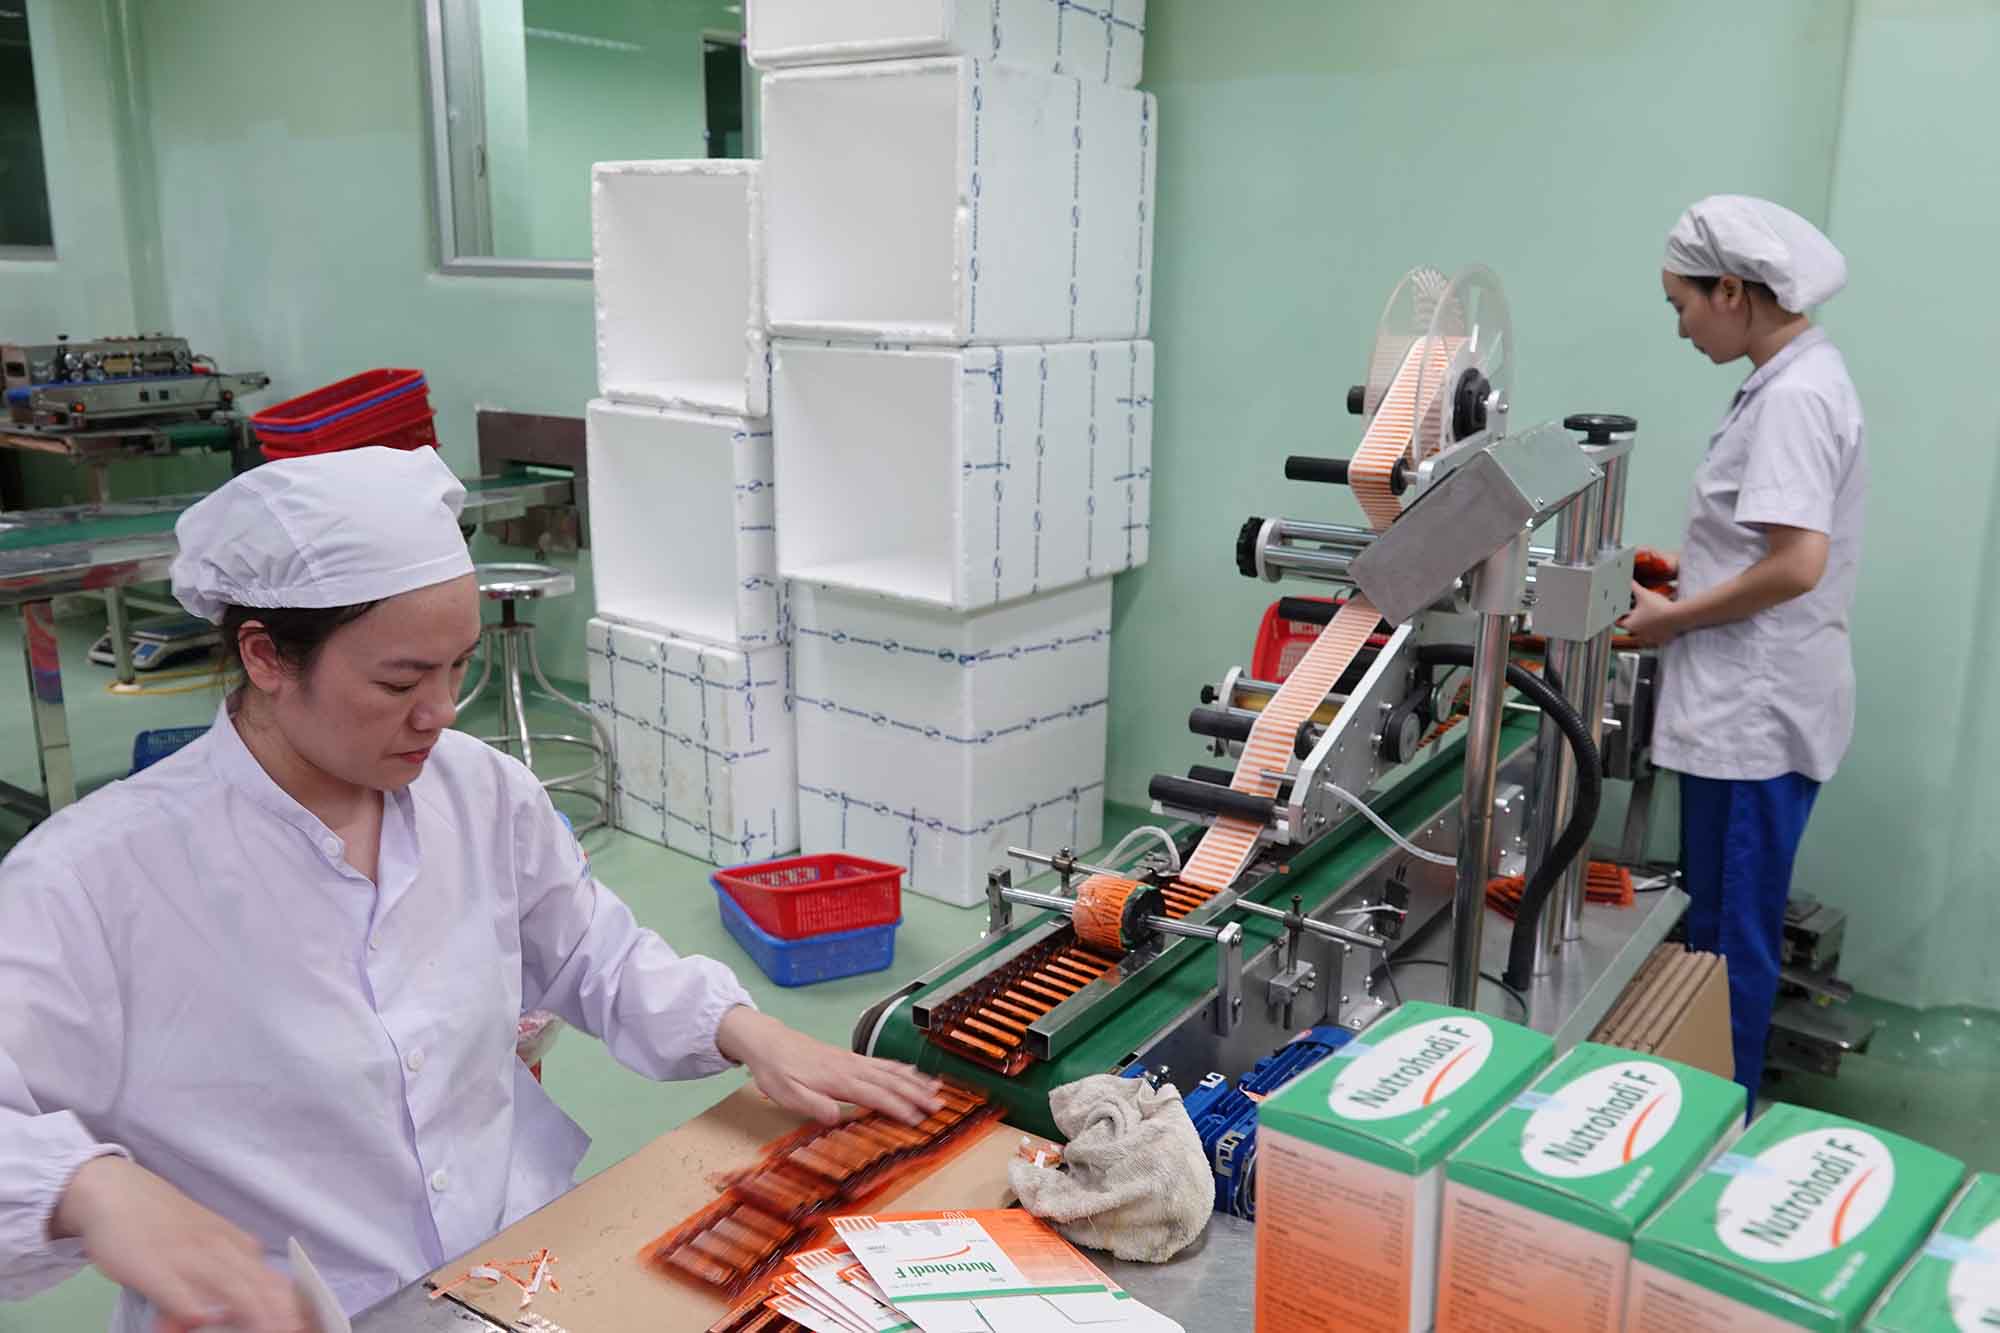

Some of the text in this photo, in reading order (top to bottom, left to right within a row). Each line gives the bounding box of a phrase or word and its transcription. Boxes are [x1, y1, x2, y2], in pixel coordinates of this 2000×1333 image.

[1348, 1024, 1471, 1109] Nutrohadi F
[1542, 1081, 1649, 1165] Nutrohadi
[1621, 1070, 1657, 1085] F
[1741, 1151, 1857, 1247] Nutrohadi
[1825, 1138, 1867, 1157] F
[895, 1261, 998, 1279] Nutrohadi F
